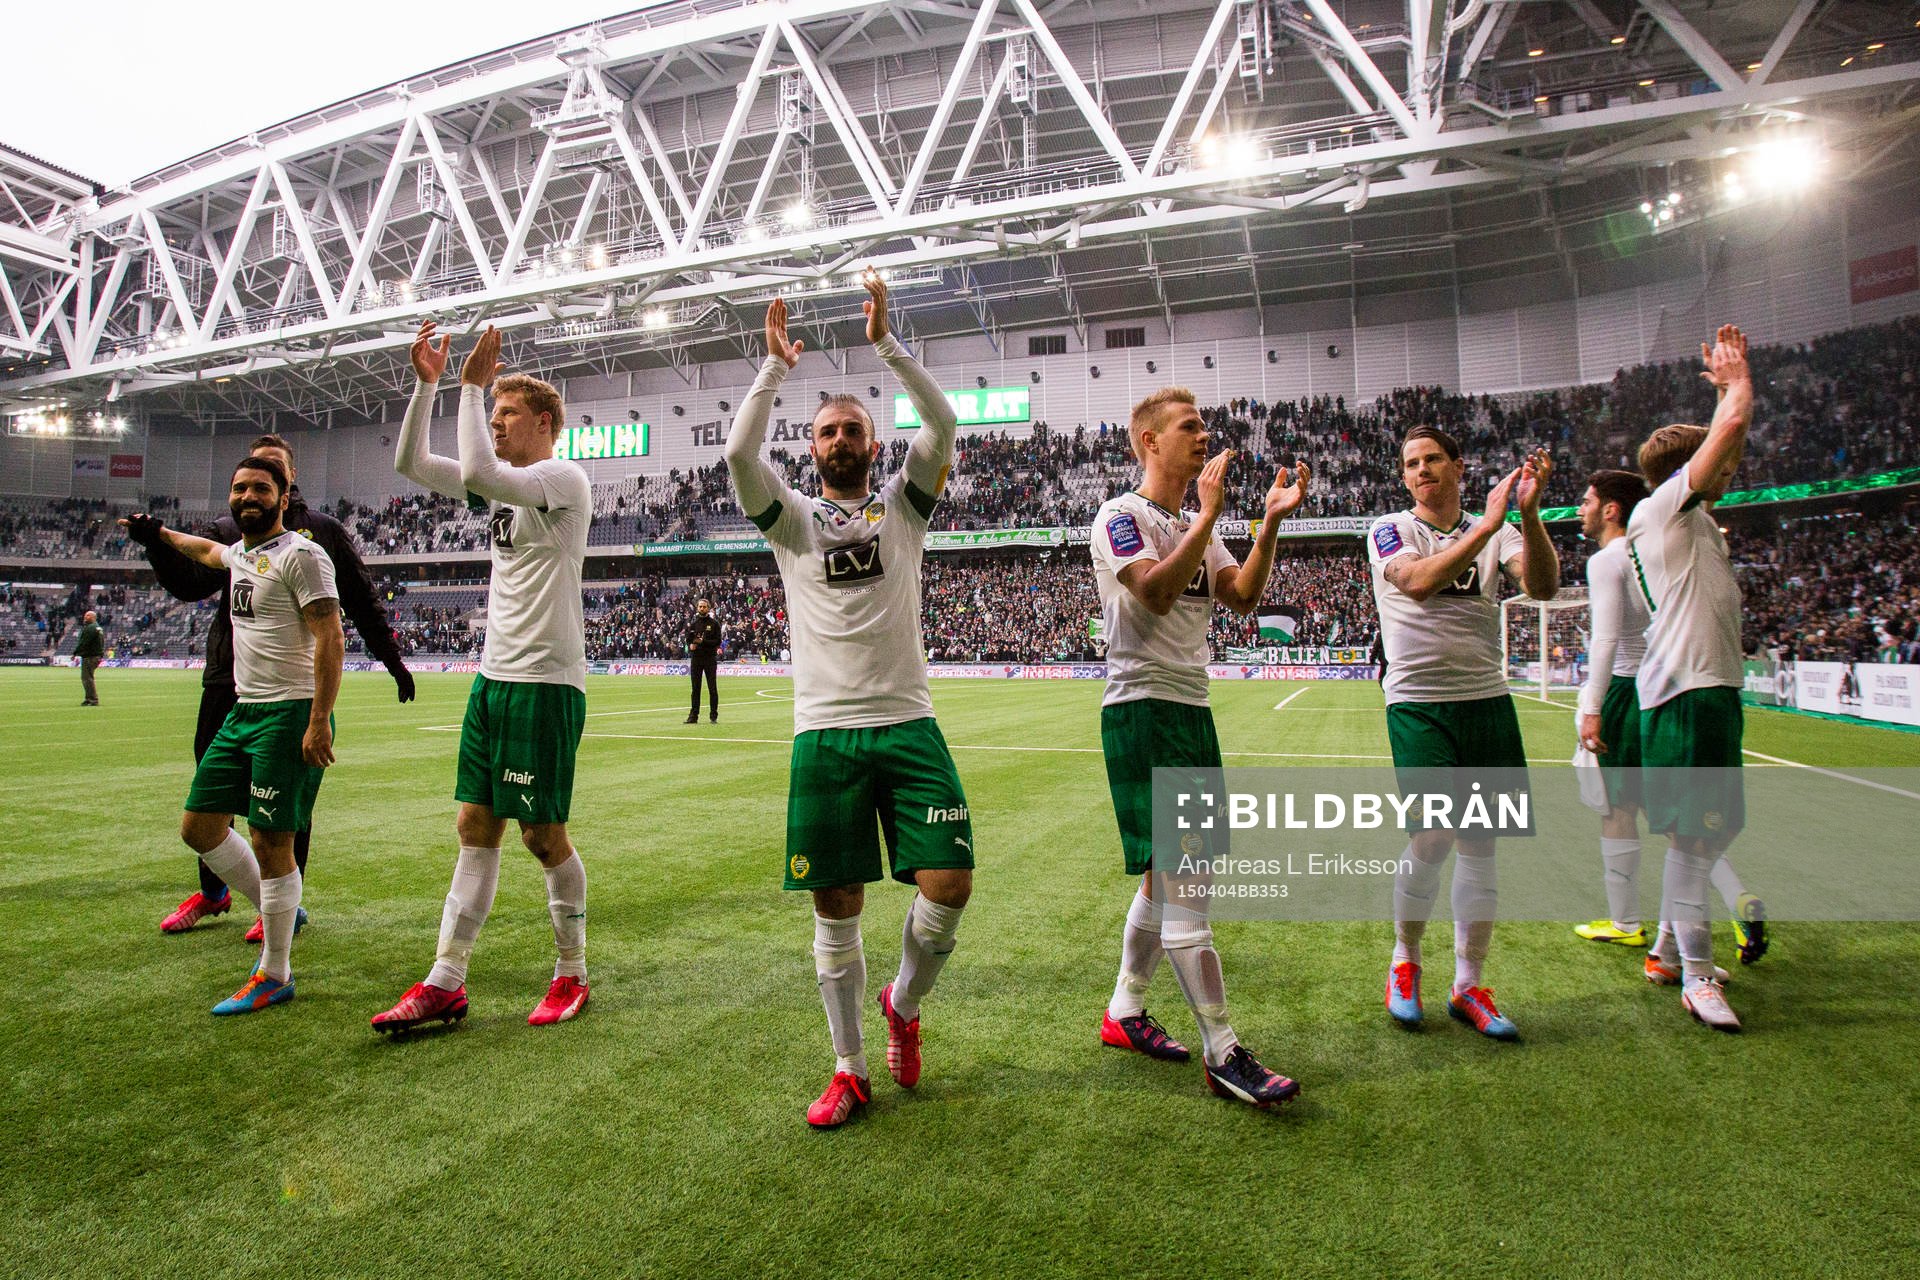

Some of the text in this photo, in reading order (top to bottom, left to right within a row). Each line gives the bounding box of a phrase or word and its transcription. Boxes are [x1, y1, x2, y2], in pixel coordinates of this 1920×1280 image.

[771, 419, 813, 441] Are
[646, 544, 683, 553] HAMMARBY
[684, 543, 711, 551] FOTBOLL
[714, 542, 757, 550] GEMENSKAP
[1268, 647, 1330, 665] BAJEN
[503, 768, 535, 785] Inair
[926, 803, 968, 824] Inair
